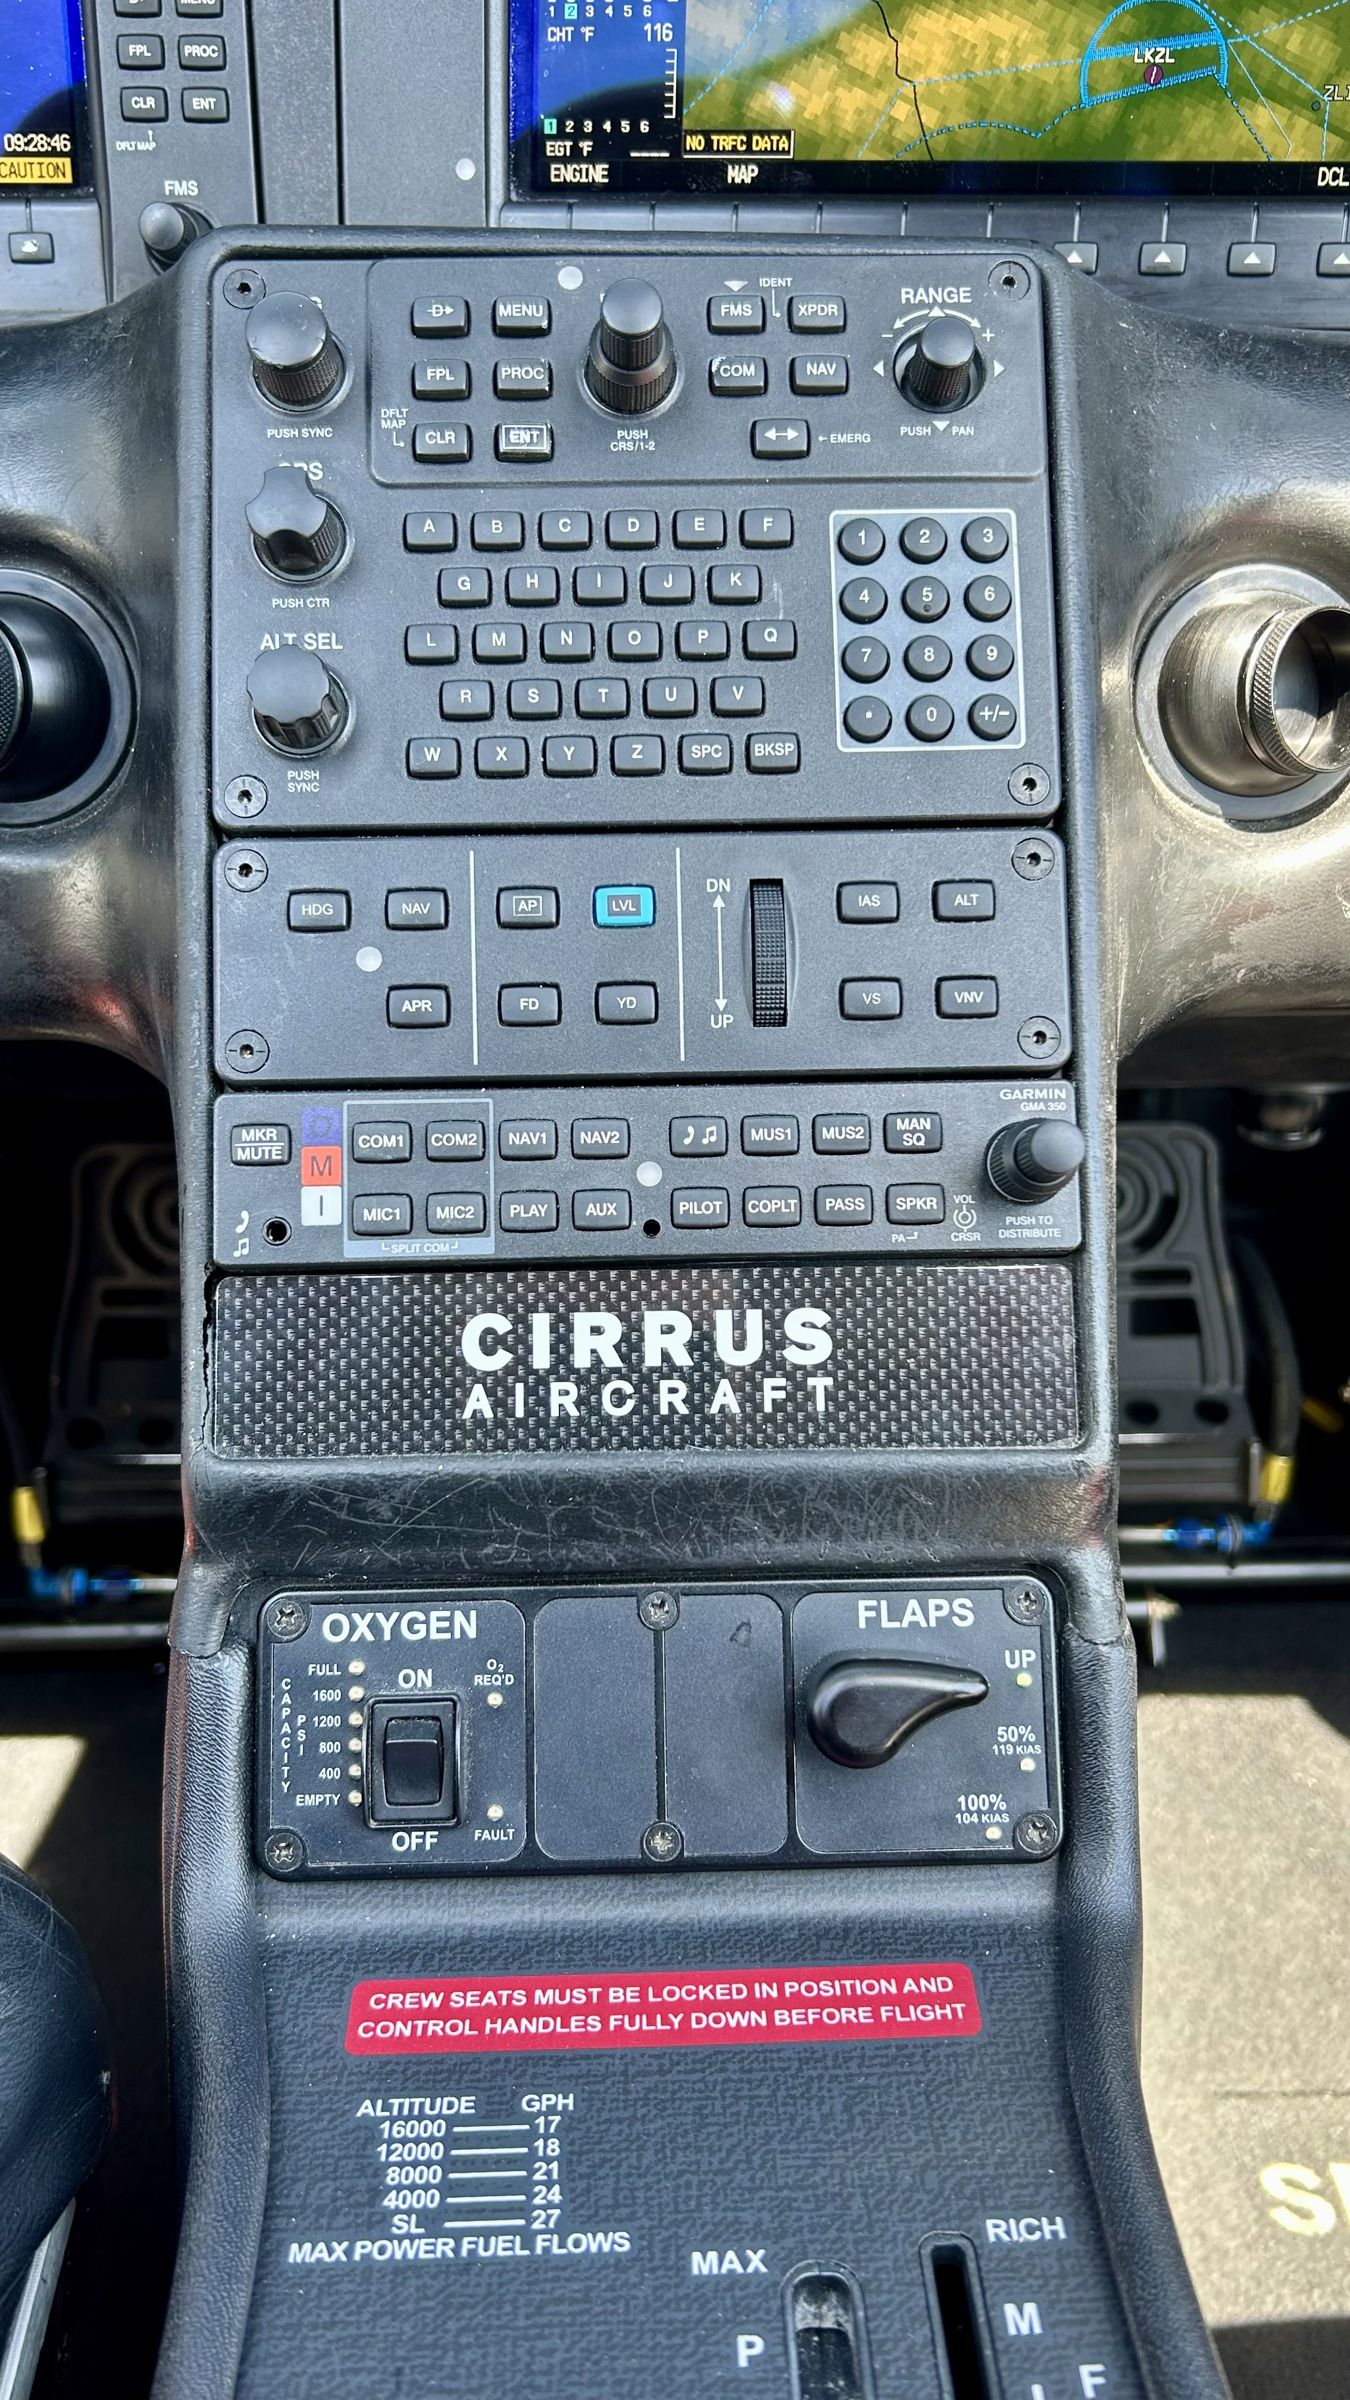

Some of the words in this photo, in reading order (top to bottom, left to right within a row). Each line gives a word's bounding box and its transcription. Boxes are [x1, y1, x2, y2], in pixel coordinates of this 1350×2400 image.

[547, 27, 574, 42] CHT
[644, 23, 673, 42] 116
[129, 44, 151, 56] FPL
[184, 45, 219, 57] PROC
[1133, 48, 1175, 64] LKZL
[131, 97, 155, 109] CLR
[192, 98, 216, 110] ENT
[4, 134, 71, 151] 09:28:46
[116, 142, 136, 150] DFLT
[137, 142, 156, 150] MAP
[546, 141, 572, 157] EGT
[686, 136, 705, 151] NO
[711, 136, 746, 151] TRFC
[752, 136, 789, 151] DATA
[0, 162, 66, 178] CAUTION
[550, 164, 609, 183] ENGINE
[727, 166, 759, 184] MAP
[1317, 167, 1349, 187] DCL
[164, 181, 198, 196] FMS
[759, 278, 792, 288] IDENT
[901, 287, 972, 304] RANGE
[499, 304, 543, 317] MENU
[721, 304, 752, 317] FMS
[799, 304, 838, 317] XPDR
[427, 368, 454, 381] FPL
[502, 367, 544, 380] PROC
[720, 364, 755, 377] COM
[806, 363, 836, 375] NAV
[381, 409, 409, 418] DFLT
[381, 419, 406, 429] MAP
[267, 428, 298, 439] PUSH
[301, 427, 333, 438] SYNC
[425, 431, 455, 444] CLR
[510, 431, 540, 444] ENT
[617, 430, 648, 440] PUSH
[900, 427, 931, 436] PUSH
[952, 426, 975, 436] PAN
[830, 434, 871, 444] EMERG
[610, 441, 656, 452] CRS/1-2
[272, 599, 303, 608] PUSH
[306, 598, 330, 608] CTR
[304, 633, 343, 650] SEL
[691, 745, 722, 758] SPC
[755, 743, 794, 757] BKSP
[288, 771, 319, 780] PUSH
[288, 782, 320, 793] SYNC
[707, 879, 730, 892] DN
[518, 900, 537, 911] AP
[613, 900, 635, 911] LVL
[859, 895, 880, 906] IAS
[954, 895, 979, 906] ALT
[302, 904, 333, 915] HDG
[402, 903, 430, 914] NAV
[617, 997, 636, 1008] YD
[863, 993, 880, 1004] VS
[954, 992, 983, 1003] VNV
[402, 1000, 432, 1012] APR
[520, 999, 538, 1010] FD
[711, 1015, 733, 1028] UP
[1000, 1089, 1066, 1100] GARMIN
[1021, 1102, 1045, 1111] GMA
[1047, 1102, 1066, 1111] 350
[897, 1118, 931, 1130] MAN
[242, 1129, 277, 1142] MKR
[431, 1134, 477, 1146] COM2
[509, 1133, 546, 1144] NAV1
[581, 1132, 619, 1143] NAV2
[751, 1128, 792, 1140] MUS1
[822, 1127, 864, 1140] MUS2
[903, 1134, 925, 1146] SQ
[359, 1135, 403, 1148] COM1
[237, 1146, 282, 1160] MUTE
[311, 1156, 332, 1176] M
[826, 1199, 865, 1211] PASS
[896, 1197, 937, 1210] SPKR
[954, 1195, 975, 1204] VOL
[437, 1206, 474, 1218] MIC2
[510, 1205, 547, 1217] PLAY
[586, 1203, 617, 1215] AUX
[679, 1202, 722, 1214] PILOT
[748, 1201, 797, 1213] COPLT
[364, 1208, 400, 1221] MIC1
[1006, 1216, 1035, 1225] PUSH
[1038, 1216, 1052, 1225] TO
[892, 1234, 905, 1243] PA
[951, 1232, 981, 1241] CRSR
[999, 1229, 1061, 1238] DISTRIBUTE
[392, 1244, 419, 1253] SPLIT
[424, 1243, 450, 1252] COM
[461, 1308, 833, 1371] CIRRUS
[462, 1377, 833, 1419] AIRCRAFT
[858, 1598, 975, 1629] FLAPS
[323, 1610, 476, 1642] OXYGEN
[1005, 1649, 1036, 1668] UP
[308, 1664, 341, 1676] FULL
[398, 1669, 433, 1688] ON
[313, 1690, 341, 1701] 1600
[313, 1716, 341, 1727] 1200
[281, 1678, 291, 1793] CAPACITY
[297, 1715, 307, 1756] PSI
[997, 1726, 1036, 1742] 50%
[320, 1742, 341, 1753] 800
[992, 1745, 1013, 1755] 119
[1016, 1744, 1042, 1754] KIAS
[319, 1768, 341, 1780] 400
[296, 1795, 341, 1806] EMPTY
[957, 1794, 1007, 1811] 100%
[955, 1814, 980, 1824] 104
[981, 1813, 1010, 1823] KIAS
[392, 1831, 439, 1851] OFF
[474, 1829, 515, 1841] FAULT
[369, 1992, 444, 2010] CREW
[449, 1990, 527, 2008] SEATS
[534, 1988, 602, 2006] MUST
[609, 1987, 640, 2003] BE
[648, 1983, 748, 2001] LOCKED
[754, 1982, 778, 1999] IN
[785, 1978, 897, 1998] POSITION
[903, 1977, 954, 1994] AND
[358, 2019, 478, 2038] CONTROL
[485, 2016, 602, 2035] HANDLES
[609, 2013, 684, 2031] FULLY
[691, 2010, 767, 2029] DOWN
[774, 2007, 874, 2027] BEFORE
[880, 2003, 966, 2022] FLIGHT
[356, 2096, 476, 2117] ALTITUDE
[522, 2093, 574, 2112] GPH
[379, 2119, 446, 2139] 16000
[534, 2116, 561, 2134] 17
[376, 2142, 444, 2162] 12000
[533, 2138, 560, 2156] 18
[386, 2166, 442, 2185] 8000
[532, 2162, 560, 2181] 21
[383, 2189, 440, 2209] 4000
[532, 2185, 563, 2204] 24
[392, 2214, 425, 2234] SL
[530, 2209, 561, 2229] 27
[986, 2218, 1066, 2243] RICH
[288, 2241, 348, 2263] MAX
[354, 2238, 454, 2261] POWER
[461, 2236, 529, 2257] FUEL
[535, 2232, 631, 2254] FLOWS
[691, 2250, 768, 2275] MAX
